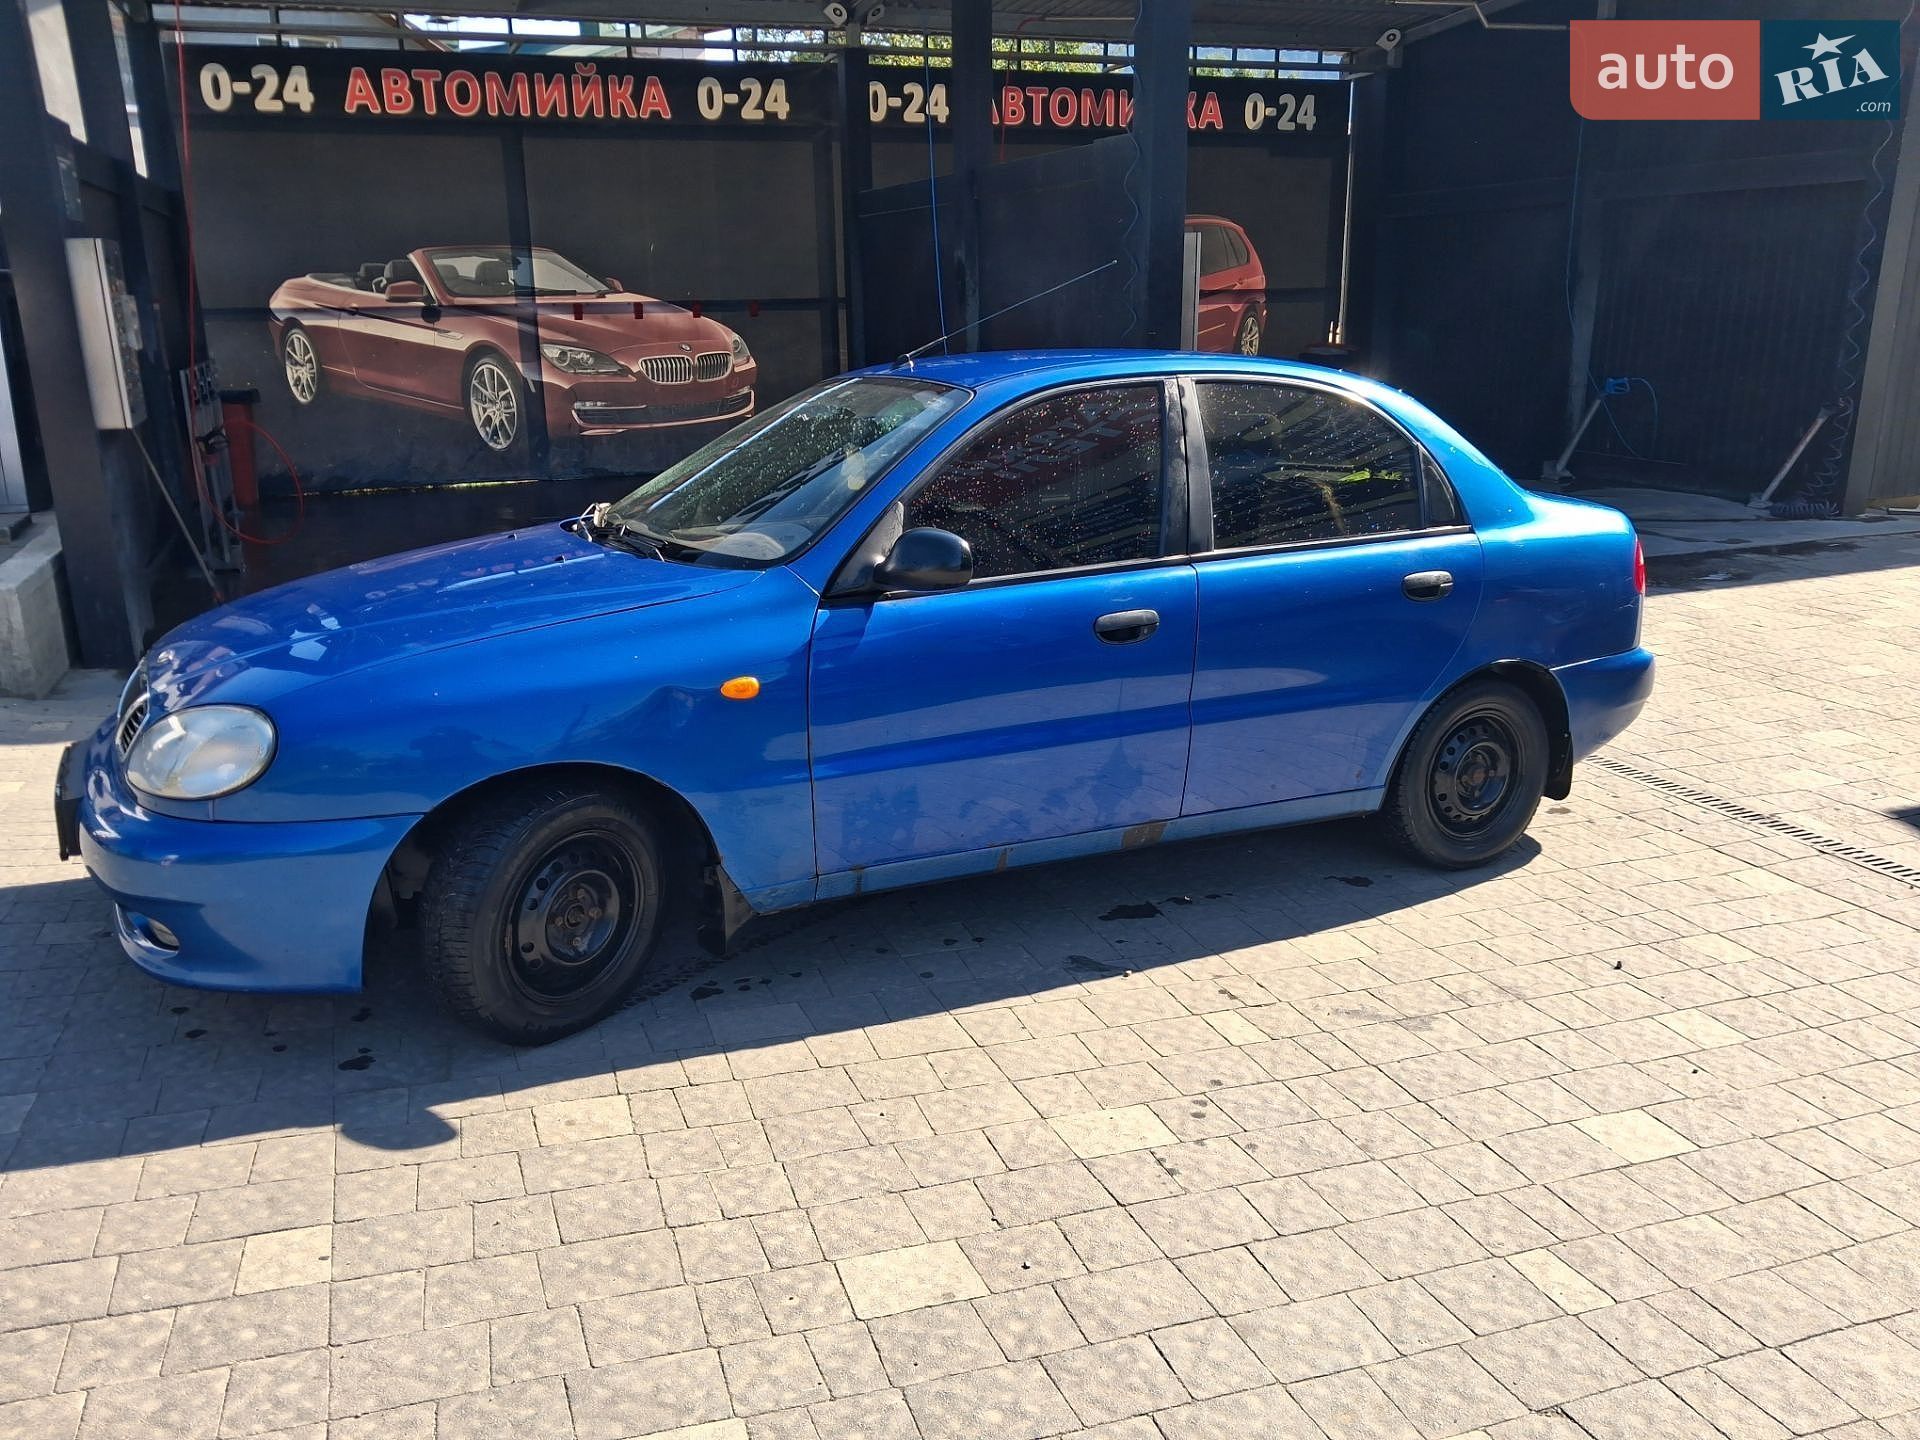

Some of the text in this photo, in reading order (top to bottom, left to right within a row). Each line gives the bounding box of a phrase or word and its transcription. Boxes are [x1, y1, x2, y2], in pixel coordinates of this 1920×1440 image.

[199, 62, 790, 121] 0-24 АВТОМИЙКА 0-24
[868, 80, 950, 124] 0-24
[1244, 91, 1317, 131] 0-24
